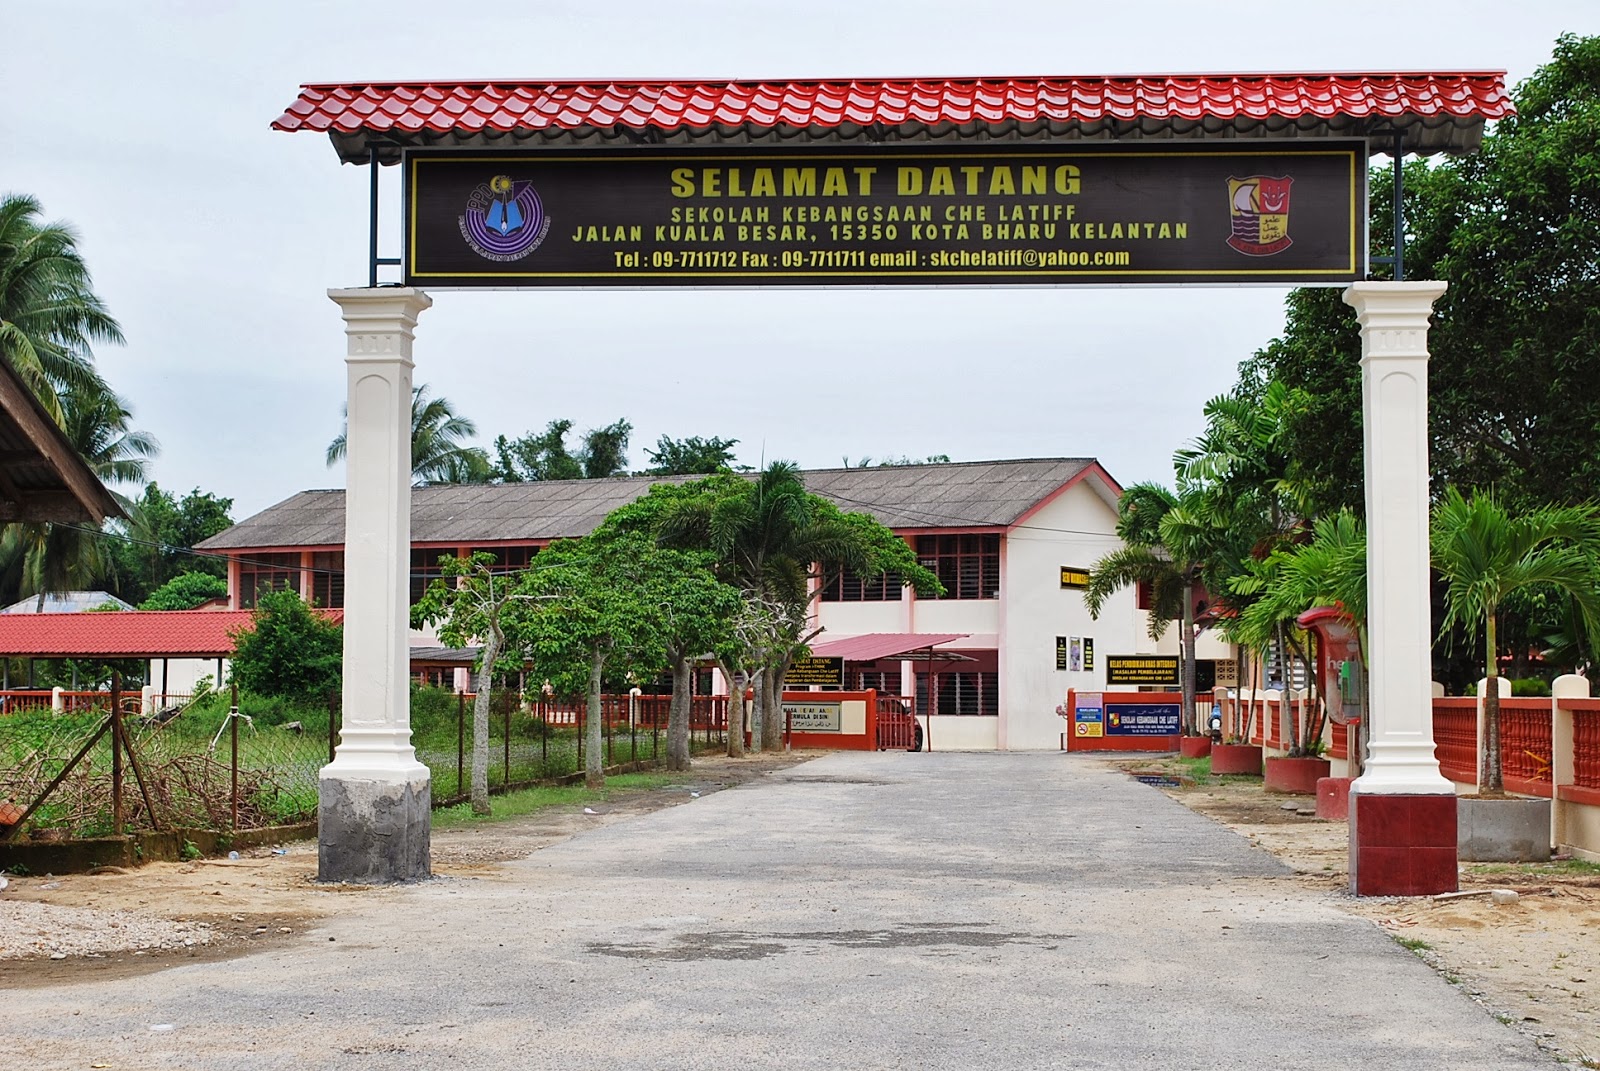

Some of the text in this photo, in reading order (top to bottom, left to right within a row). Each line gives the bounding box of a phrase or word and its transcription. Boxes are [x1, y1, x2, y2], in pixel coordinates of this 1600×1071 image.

[671, 165, 1081, 199] SELAMAT DATANG
[466, 183, 495, 211] PPD
[670, 204, 1077, 226] SEKOLAH KEBANGSAAN CHE LATIFF
[572, 222, 1189, 244] JALAN KUALA BESAR, 15350 KOTA BHARU KELANTAN
[614, 251, 639, 267] Tel
[652, 251, 738, 267] 09-7711712
[742, 251, 769, 267] Fax
[781, 250, 865, 267] 09-7711711
[869, 250, 917, 266] email
[930, 249, 1130, 268] skchelatiff@yahoo.com
